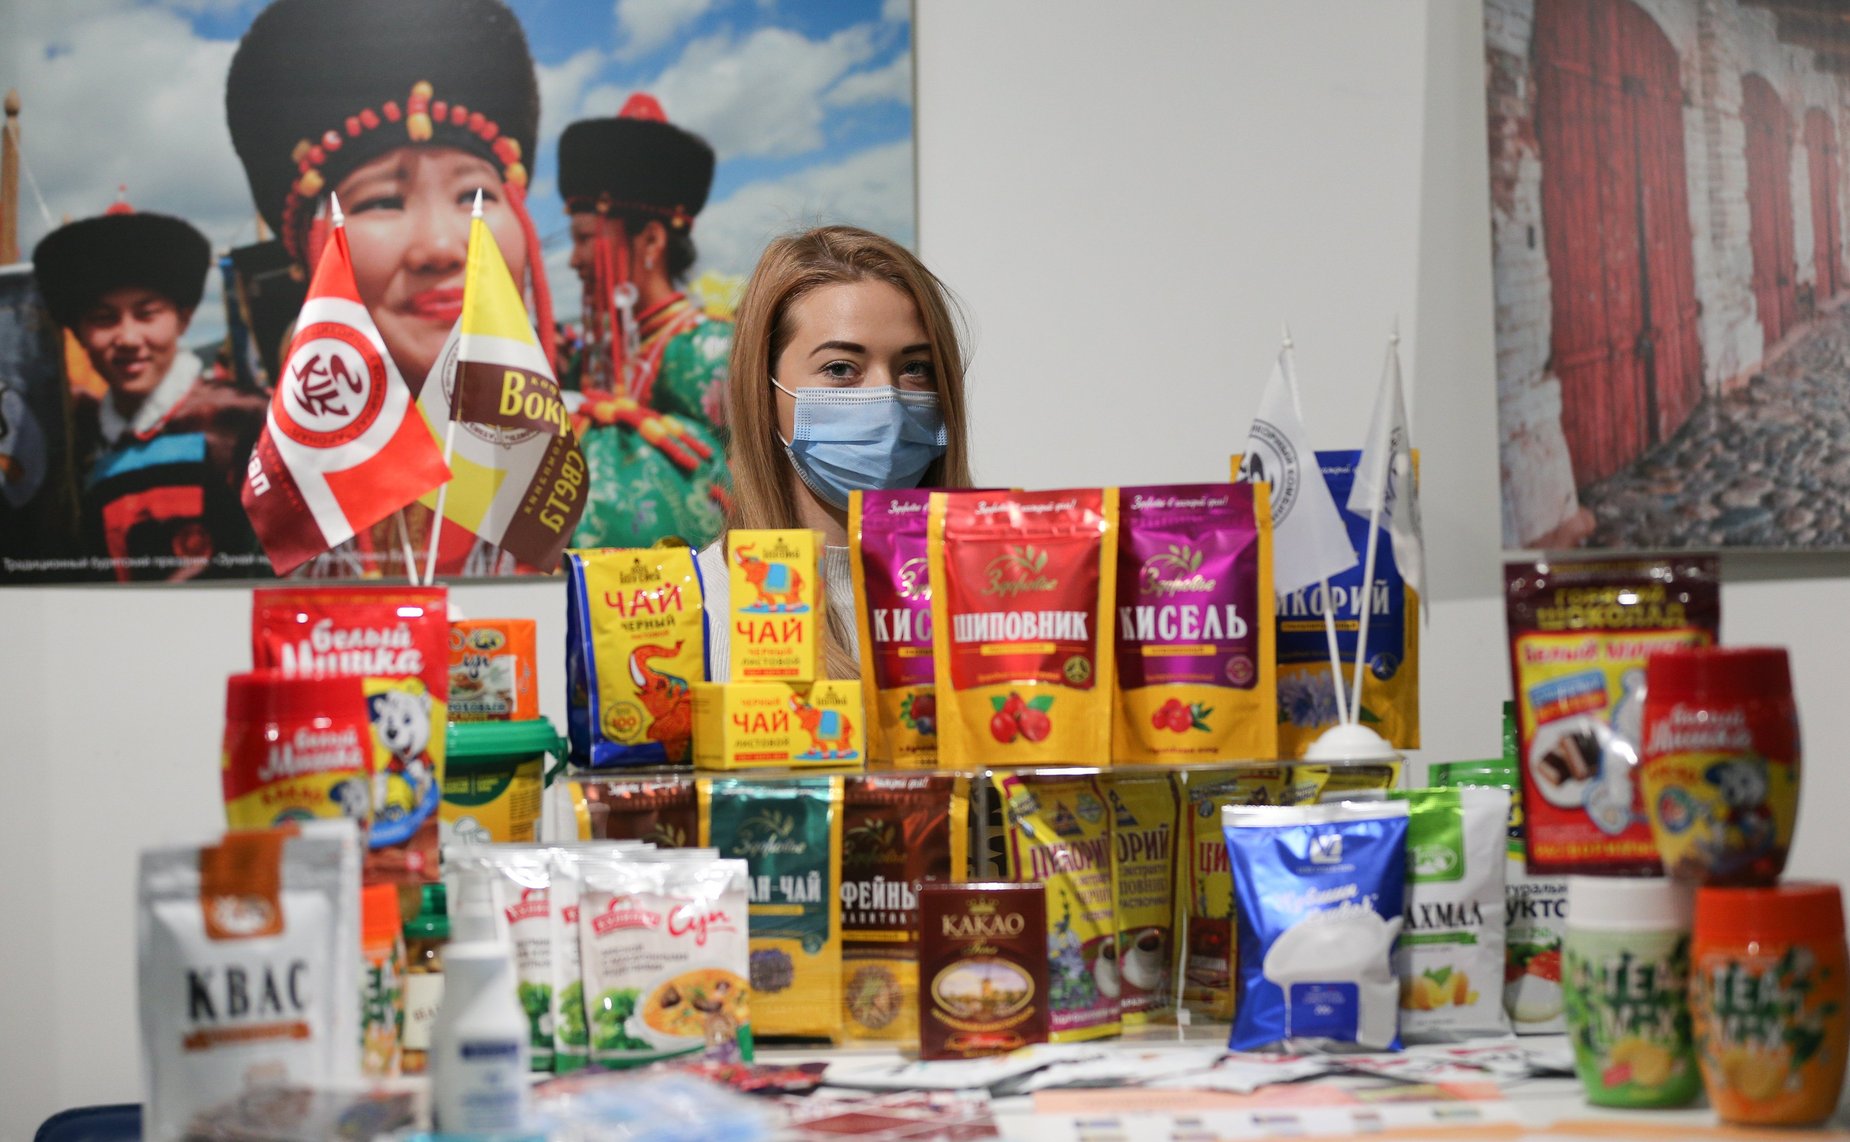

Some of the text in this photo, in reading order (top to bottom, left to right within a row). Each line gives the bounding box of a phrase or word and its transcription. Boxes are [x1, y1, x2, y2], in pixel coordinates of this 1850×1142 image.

[246, 450, 272, 498] ап
[604, 582, 683, 619] ЧАЙ
[1275, 579, 1390, 617] ИКОРИЙ
[621, 614, 676, 631] ЧЕРНЫЙ
[736, 618, 802, 644] ЧАЙ
[873, 608, 933, 643] КИС
[952, 610, 1089, 644] ШИПОВНИК
[1118, 604, 1249, 643] КИСЕЛЬ
[732, 709, 789, 734] ЧАЙ
[1199, 841, 1228, 876] ЦИ
[747, 869, 822, 903] АН-ЧАЙ
[941, 911, 1026, 938] КАКАО
[1402, 899, 1485, 930] АХМАЛ
[184, 957, 311, 1023] КВАС
